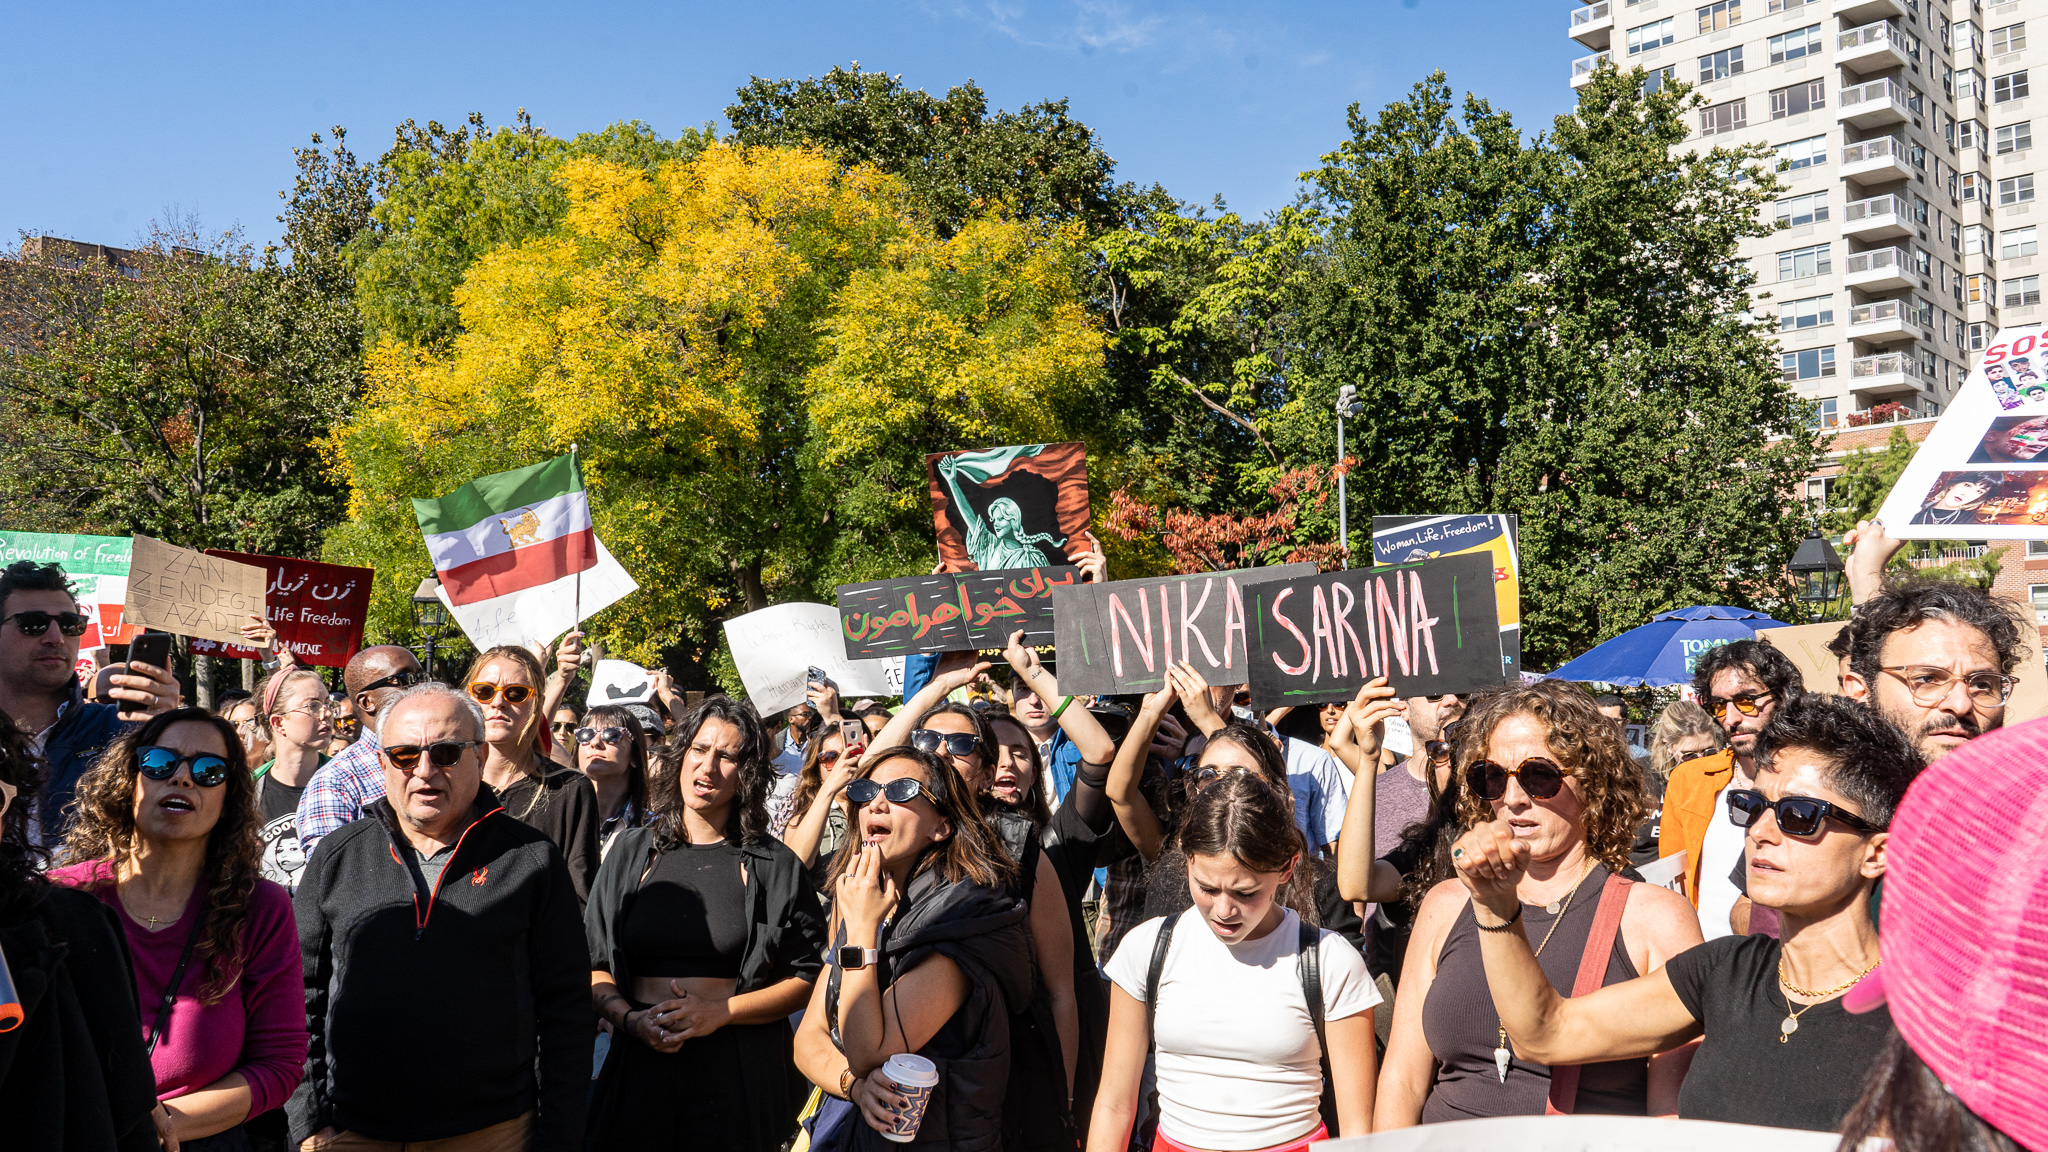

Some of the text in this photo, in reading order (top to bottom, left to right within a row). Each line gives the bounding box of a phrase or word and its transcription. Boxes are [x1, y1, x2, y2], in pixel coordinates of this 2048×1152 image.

[94, 543, 132, 563] Freedo
[164, 549, 225, 582] ZAN
[132, 568, 261, 614] ZENDEGI
[163, 602, 245, 635] AZADI
[265, 606, 351, 626] Life Freedom
[1109, 576, 1249, 678] NIKA
[1272, 569, 1440, 684] SARINA
[1680, 638, 1752, 657] TOM
[760, 675, 805, 699] Human
